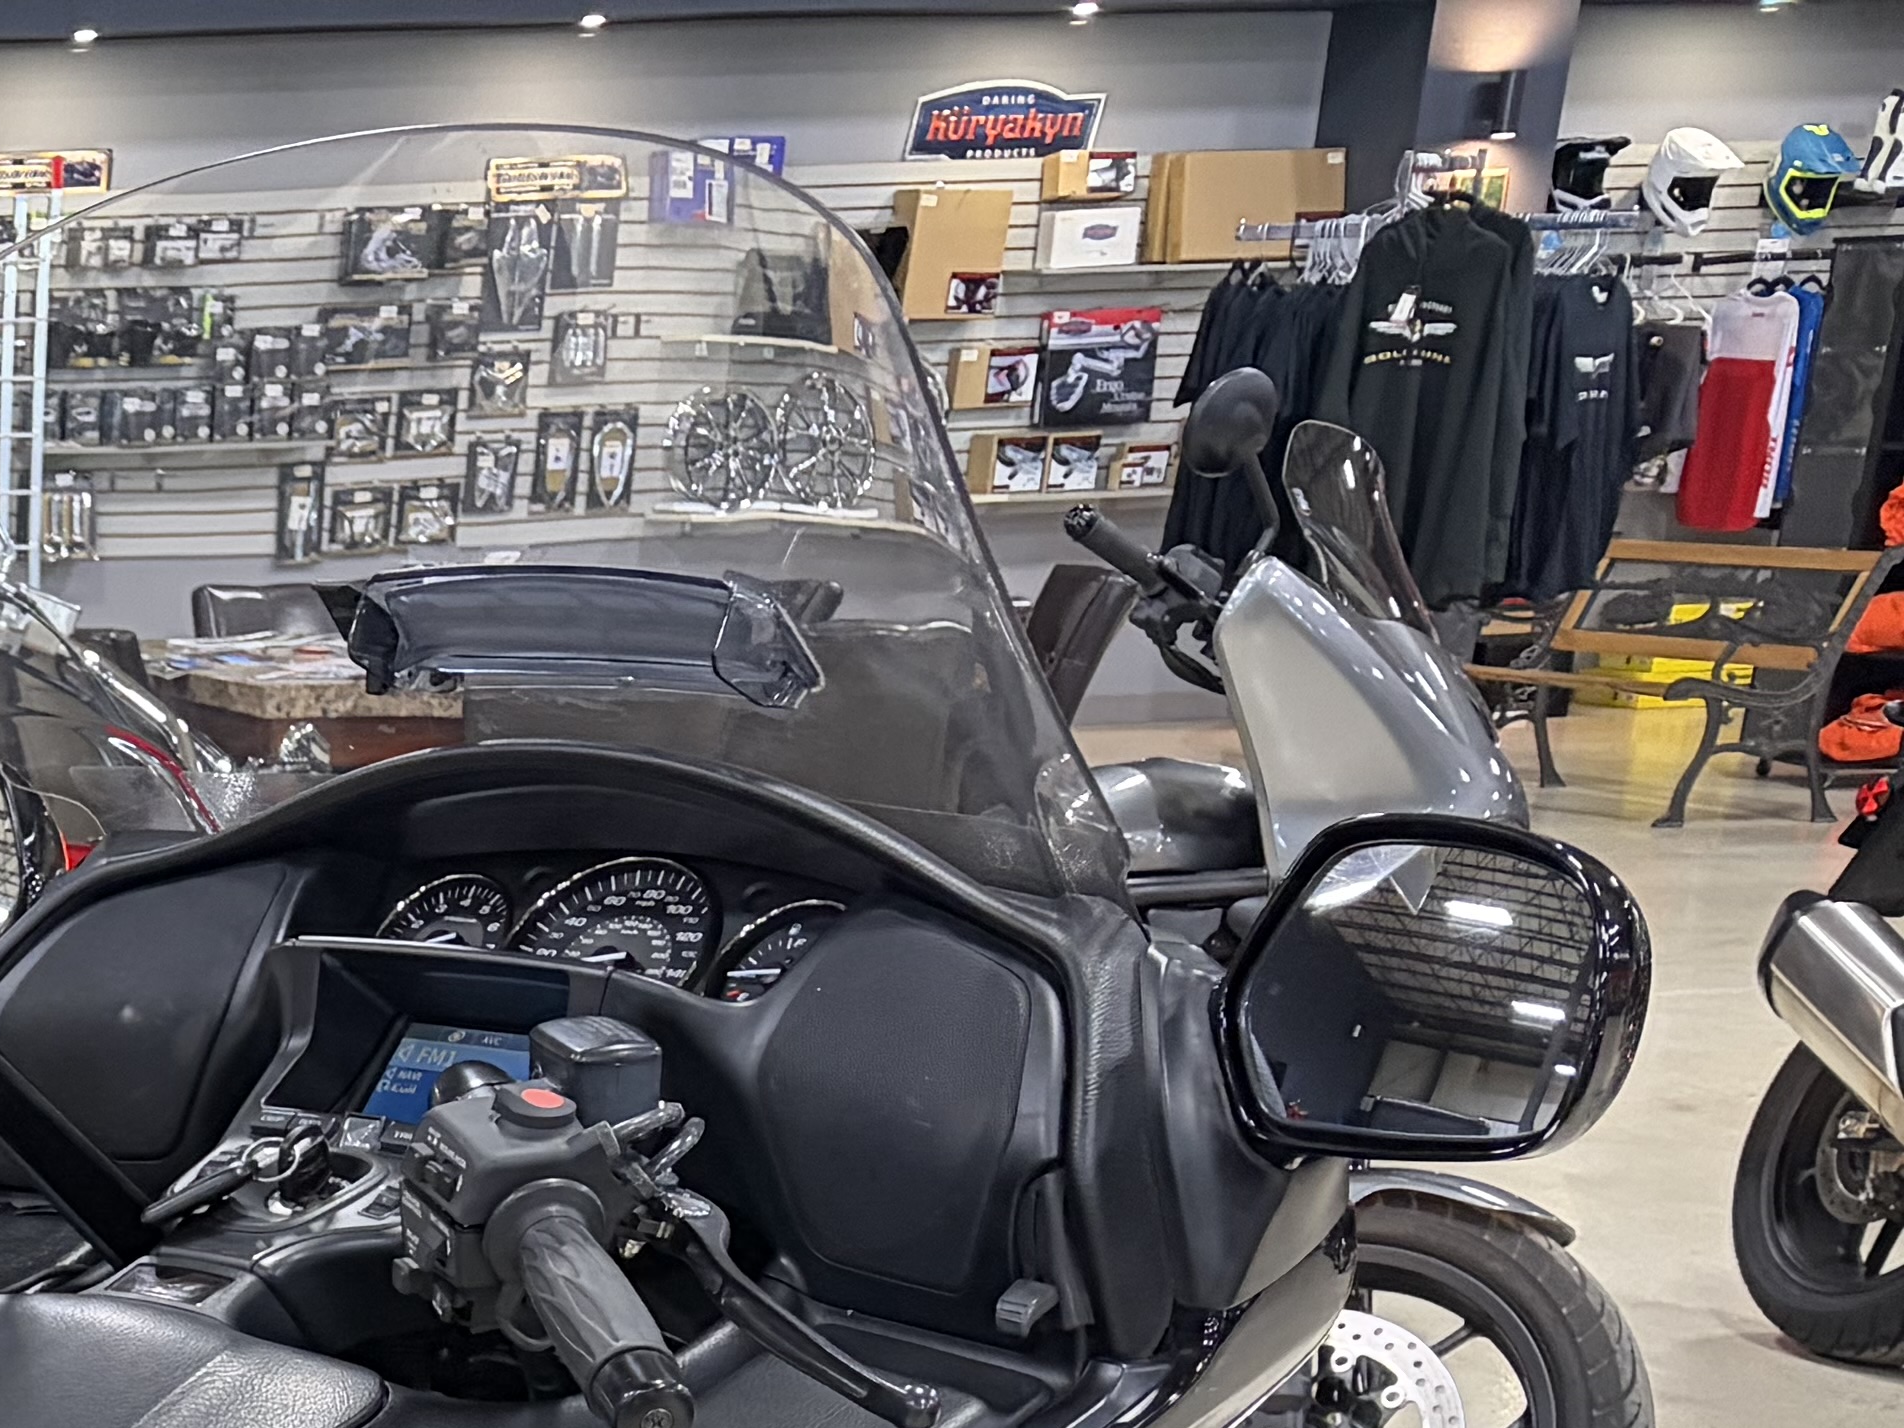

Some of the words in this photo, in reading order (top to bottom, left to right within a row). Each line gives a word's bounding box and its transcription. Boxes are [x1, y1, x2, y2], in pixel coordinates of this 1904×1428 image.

[981, 94, 1036, 106] DARING
[926, 106, 1084, 146] Küryakyn
[965, 147, 1037, 159] PRODUCTS
[564, 917, 587, 927] 40
[675, 931, 703, 942] 120
[417, 1047, 457, 1066] FM1
